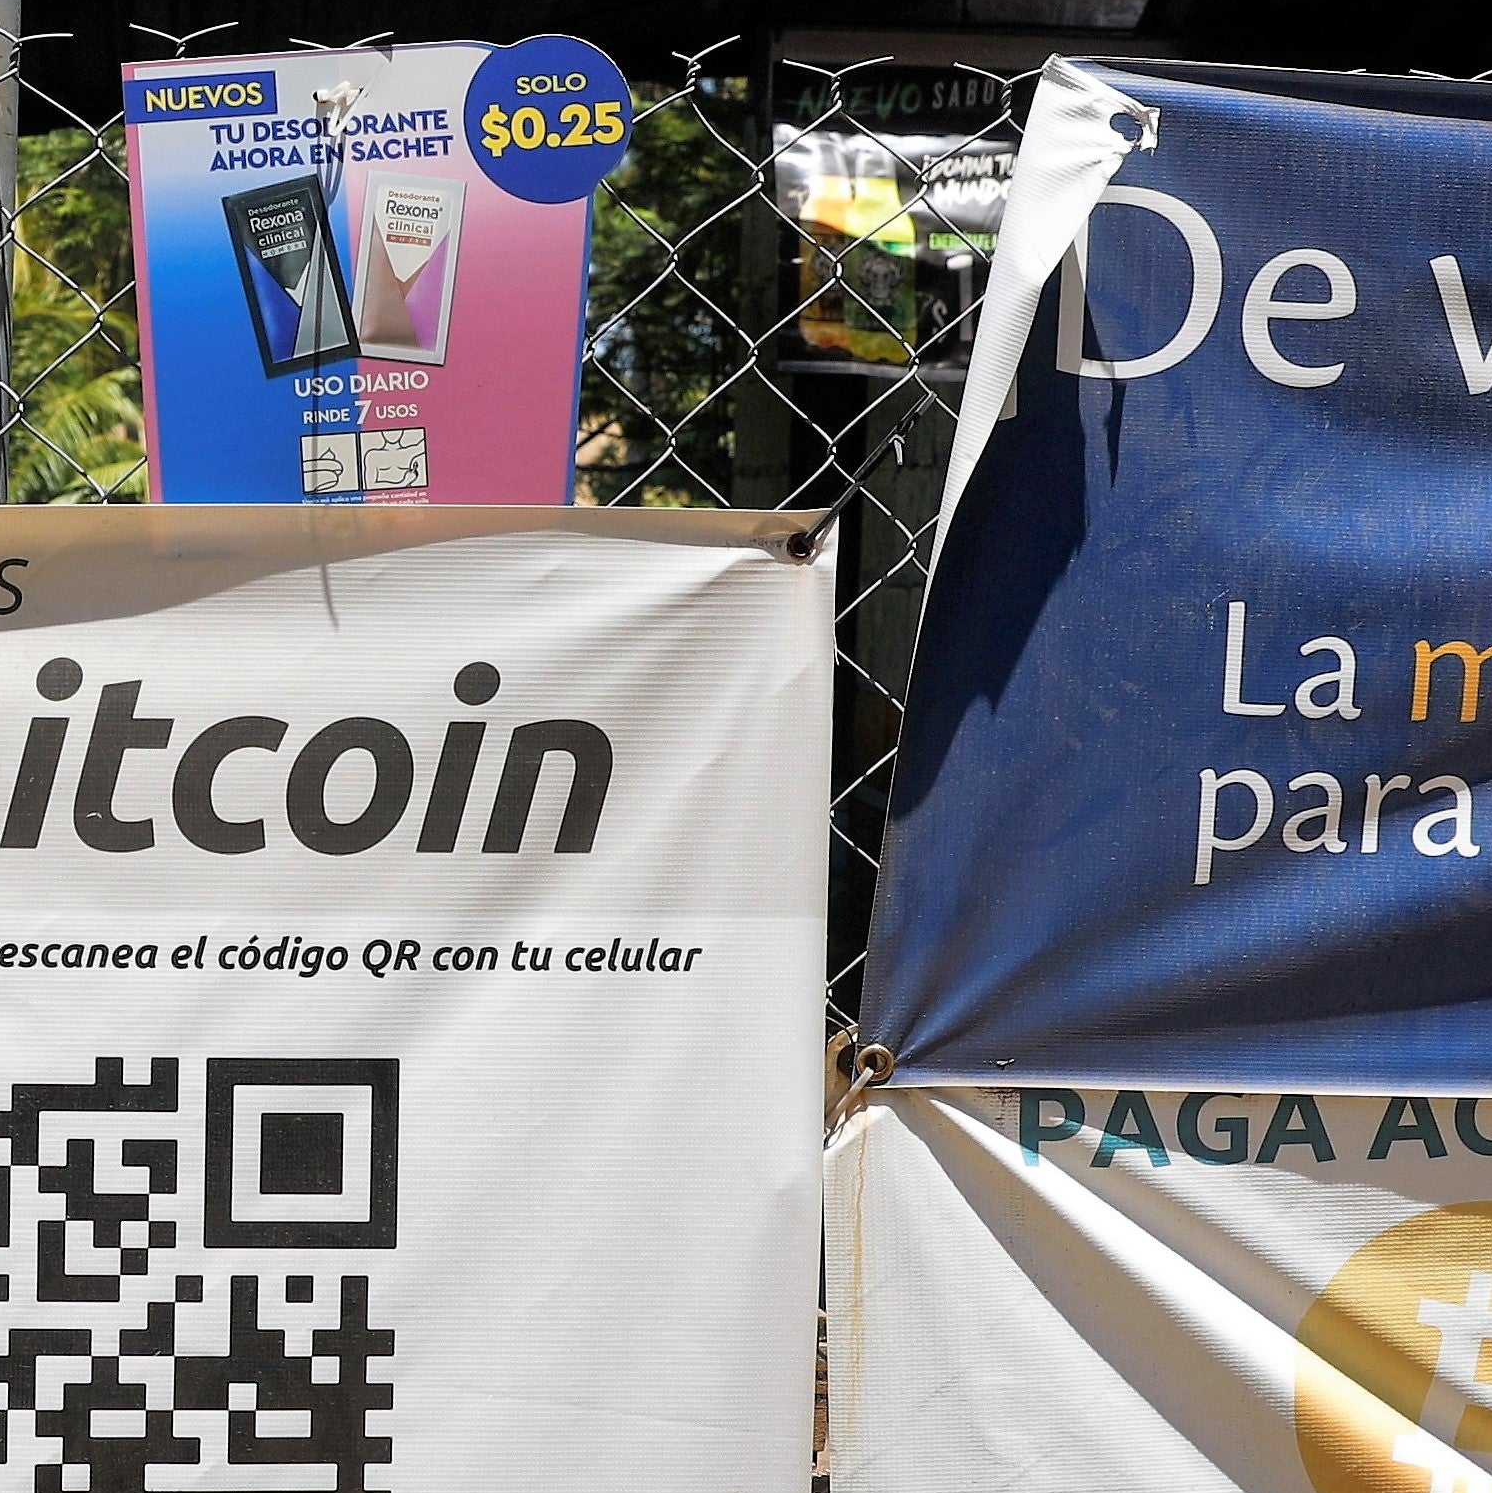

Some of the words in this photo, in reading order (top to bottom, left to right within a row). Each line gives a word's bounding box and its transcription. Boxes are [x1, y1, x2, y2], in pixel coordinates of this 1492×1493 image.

[144, 81, 266, 112] NUEVOS
[515, 72, 587, 96] SOLO
[210, 123, 248, 146] TU
[480, 101, 627, 158] $0.25
[210, 146, 307, 172] AHORA
[310, 143, 345, 167] EN
[351, 135, 455, 163] SACHET
[385, 199, 441, 220] Rexona
[388, 190, 441, 203] Desodorante
[249, 209, 304, 234] Rexona
[387, 220, 434, 235] clinical
[258, 226, 305, 248] clinical
[294, 375, 344, 398] USO
[349, 371, 430, 393] DIARIO
[302, 407, 351, 424] RINDE
[353, 400, 372, 425] 7
[375, 403, 418, 419] USOS
[1222, 599, 1360, 721] La
[1194, 765, 1480, 886] para
[171, 934, 207, 971] el
[217, 932, 349, 978] código
[361, 939, 420, 979] QR
[431, 941, 498, 971] con
[511, 938, 553, 971] tu
[564, 937, 704, 974] celular
[1017, 1088, 1337, 1168] PAGA
